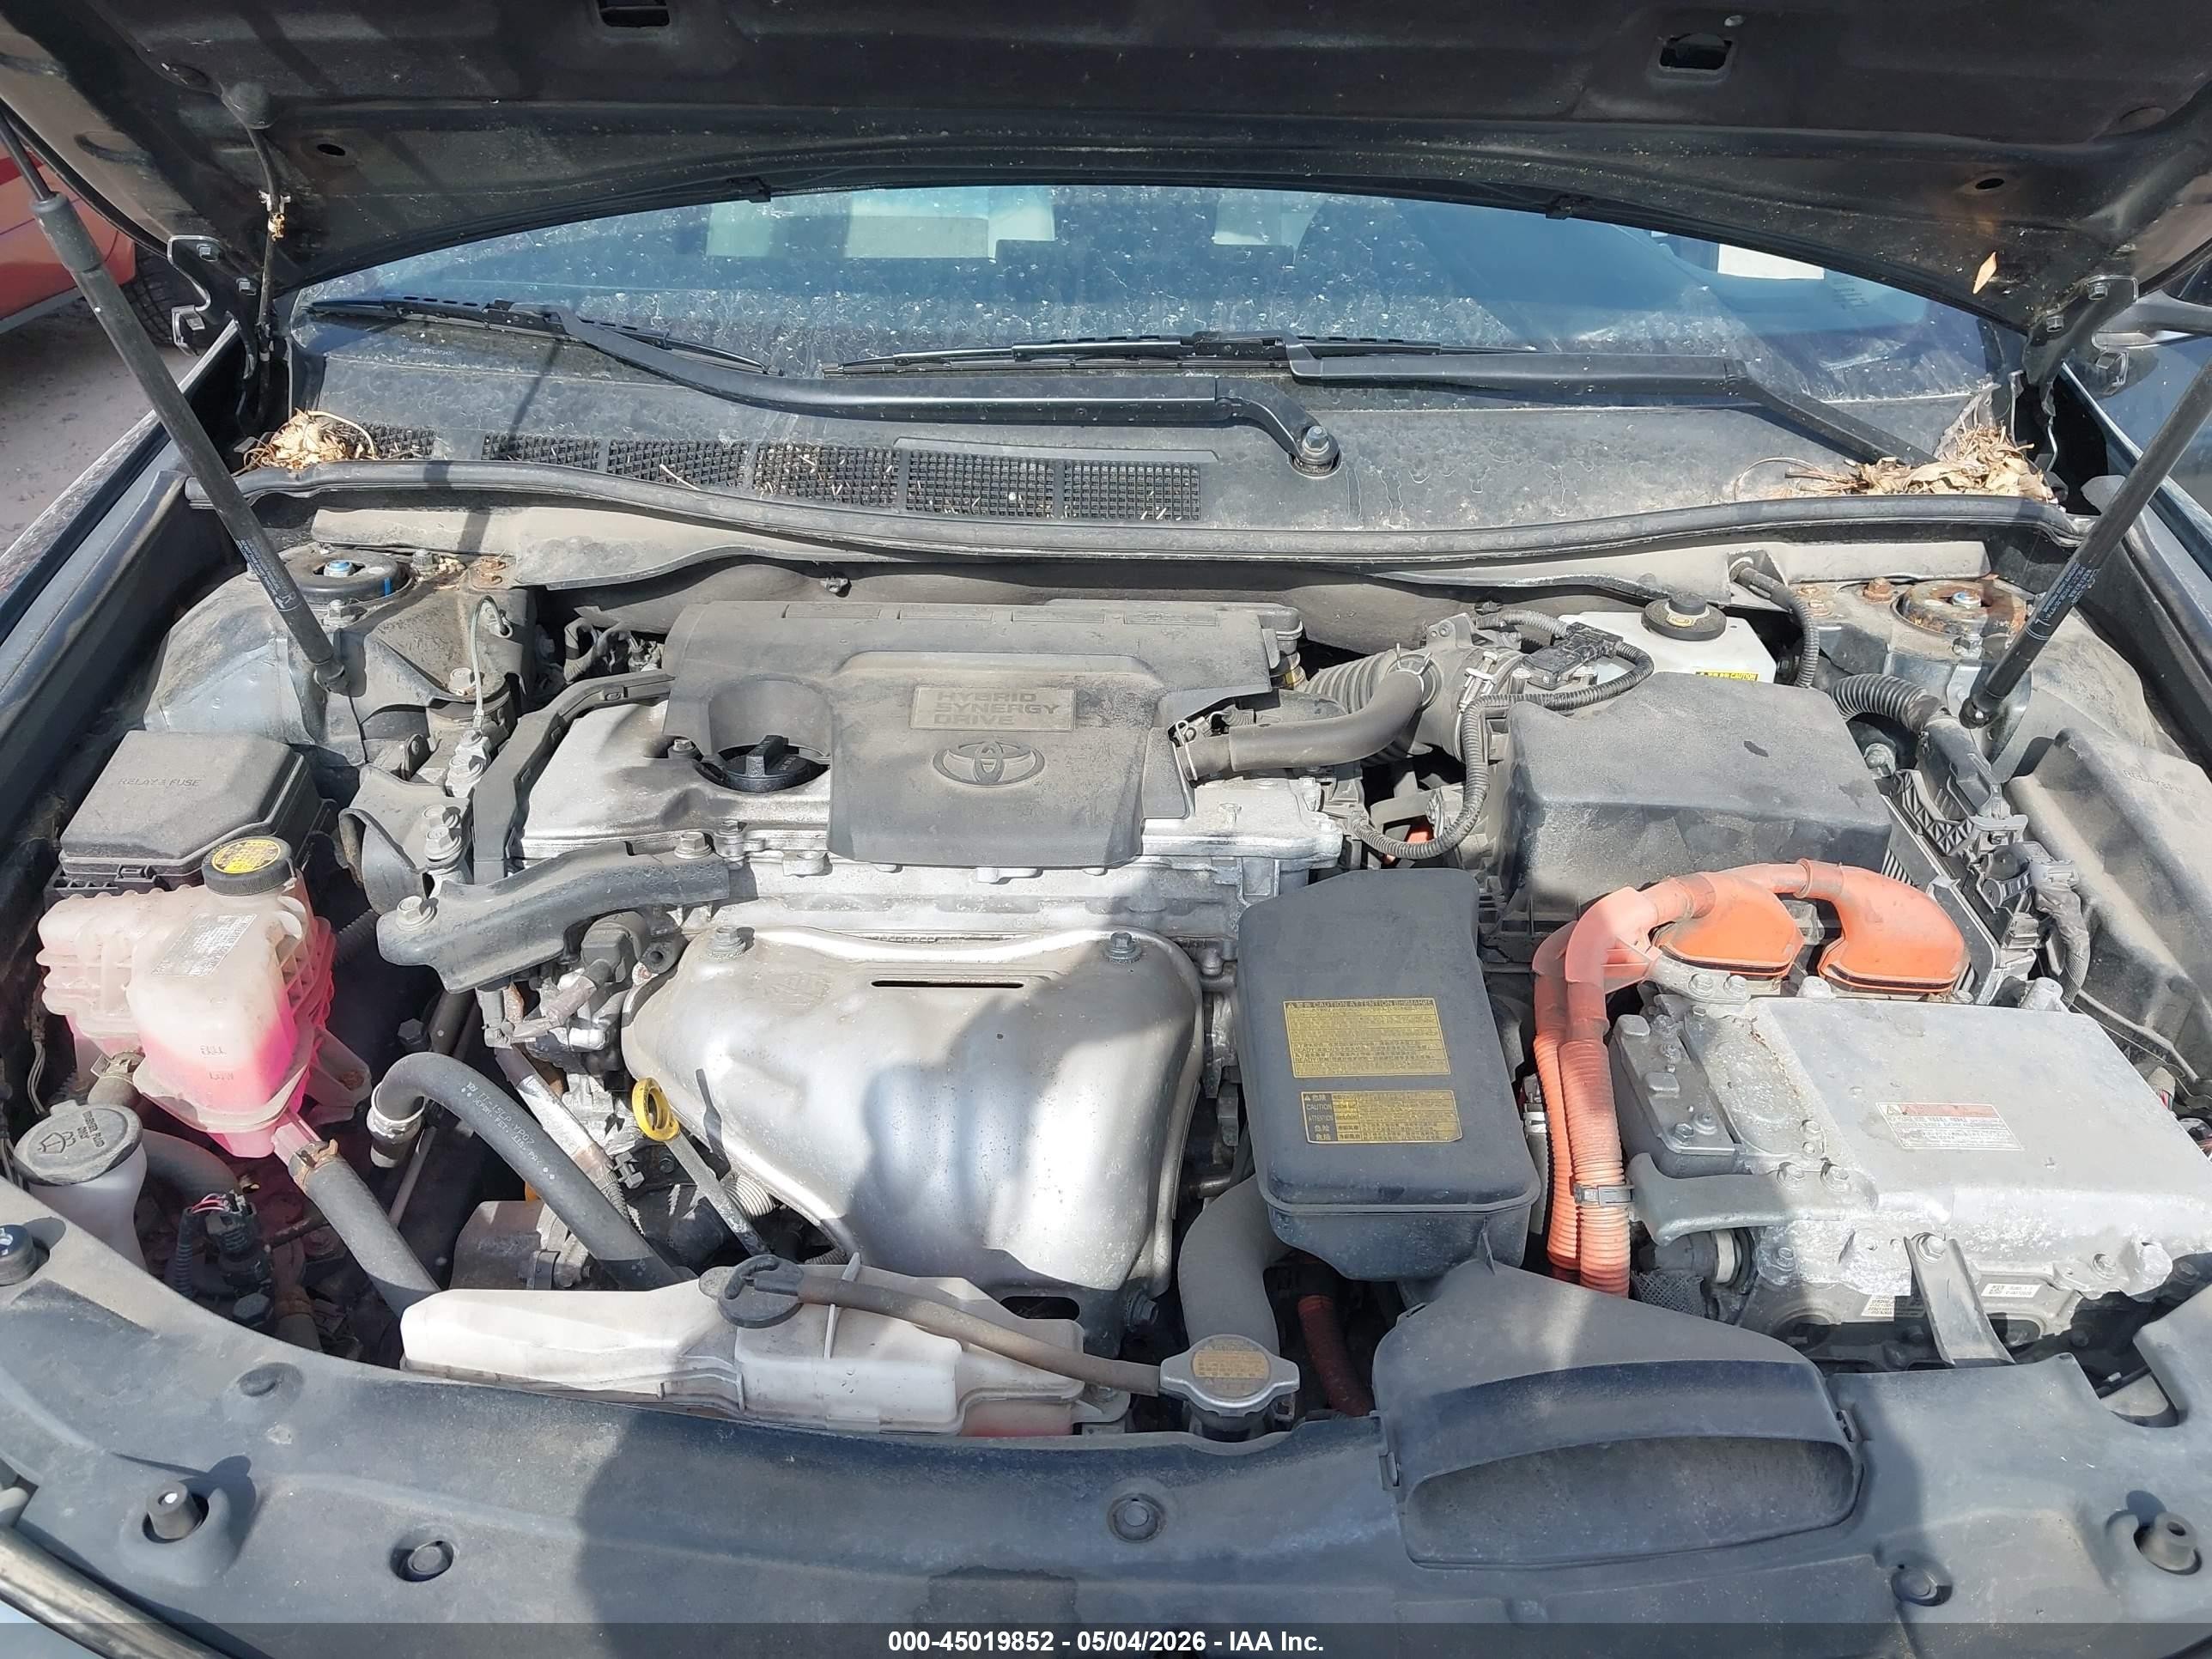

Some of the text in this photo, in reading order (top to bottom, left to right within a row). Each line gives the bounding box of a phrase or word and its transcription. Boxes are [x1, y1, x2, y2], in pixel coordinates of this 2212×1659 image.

[1730, 672, 1757, 682] CAUTION
[937, 692, 1037, 702] HYBRID
[934, 702, 1060, 714] SYNERGY
[933, 714, 1015, 725] DRIVE
[118, 777, 158, 786] RELAY
[169, 778, 203, 787] FUSE
